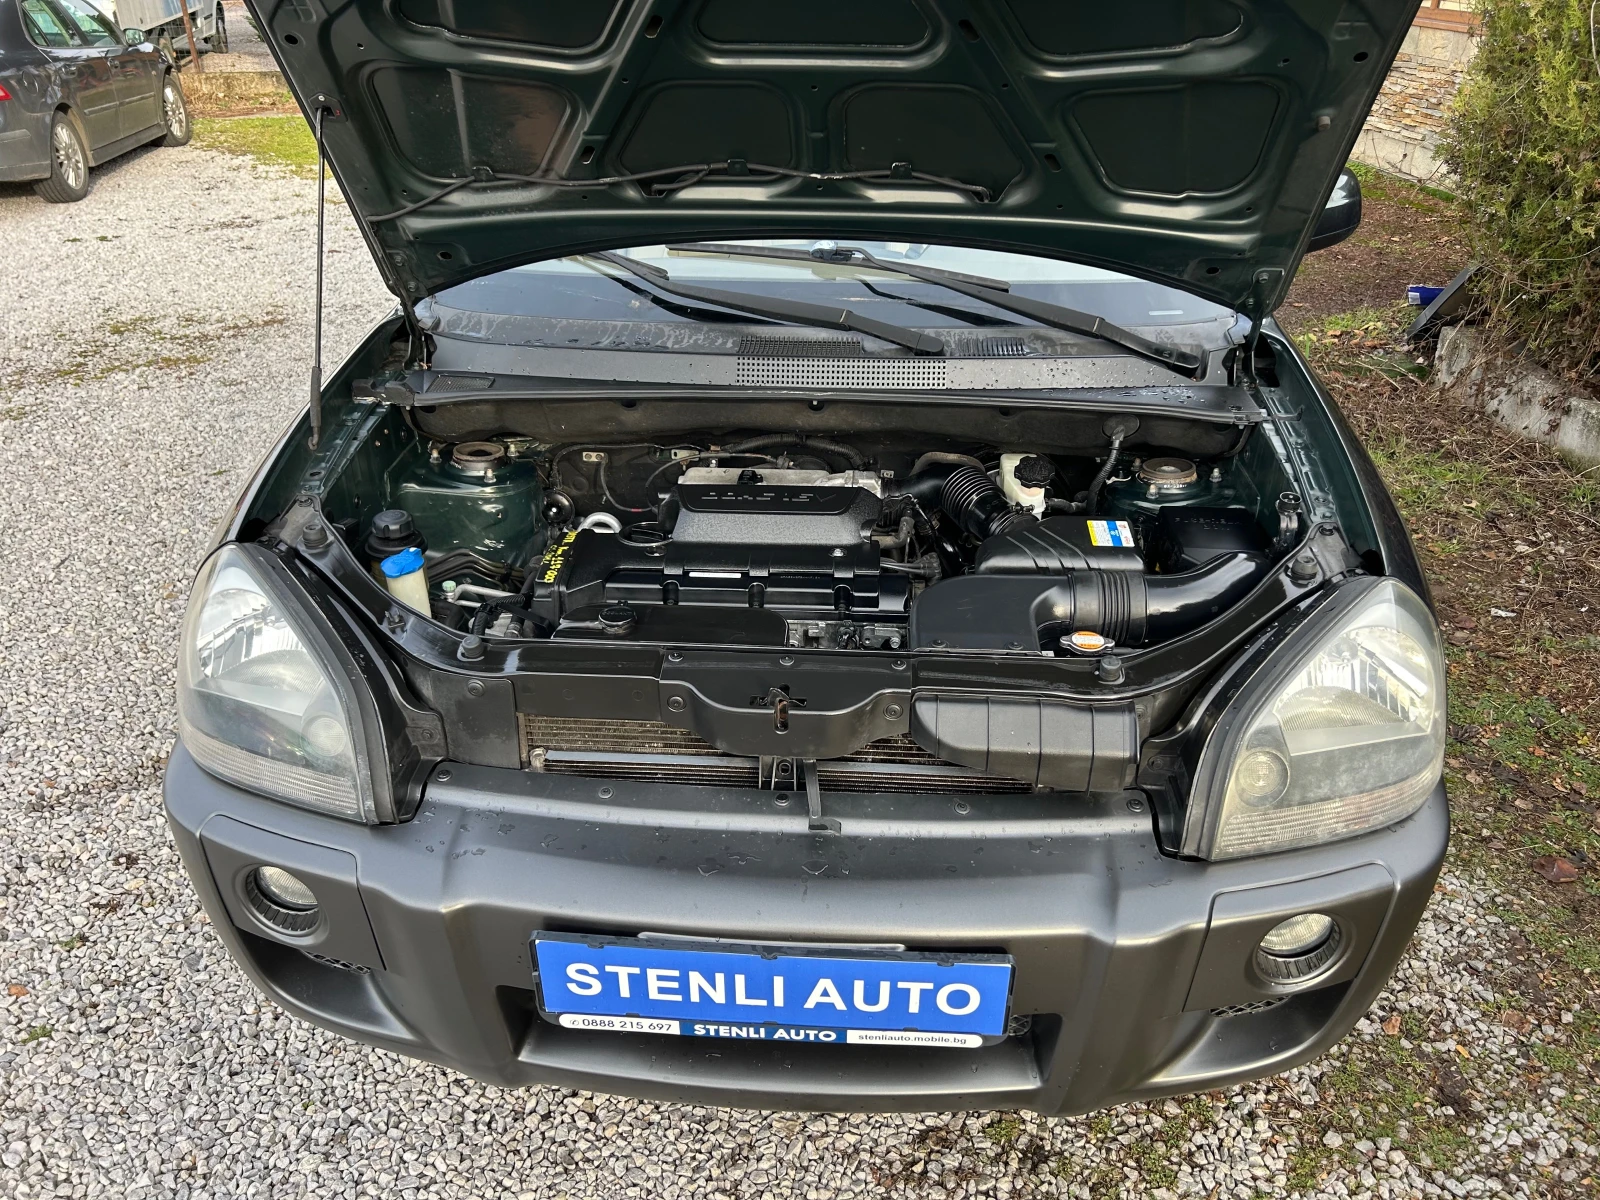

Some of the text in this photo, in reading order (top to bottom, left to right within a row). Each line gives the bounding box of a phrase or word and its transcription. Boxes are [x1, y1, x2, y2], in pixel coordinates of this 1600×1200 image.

[565, 962, 981, 1016] STENLI AUTO
[582, 1018, 672, 1032] 0888 215 697
[693, 1024, 837, 1041] STENLI AUTO
[858, 1033, 967, 1045] stenliauto.mobile.bg
